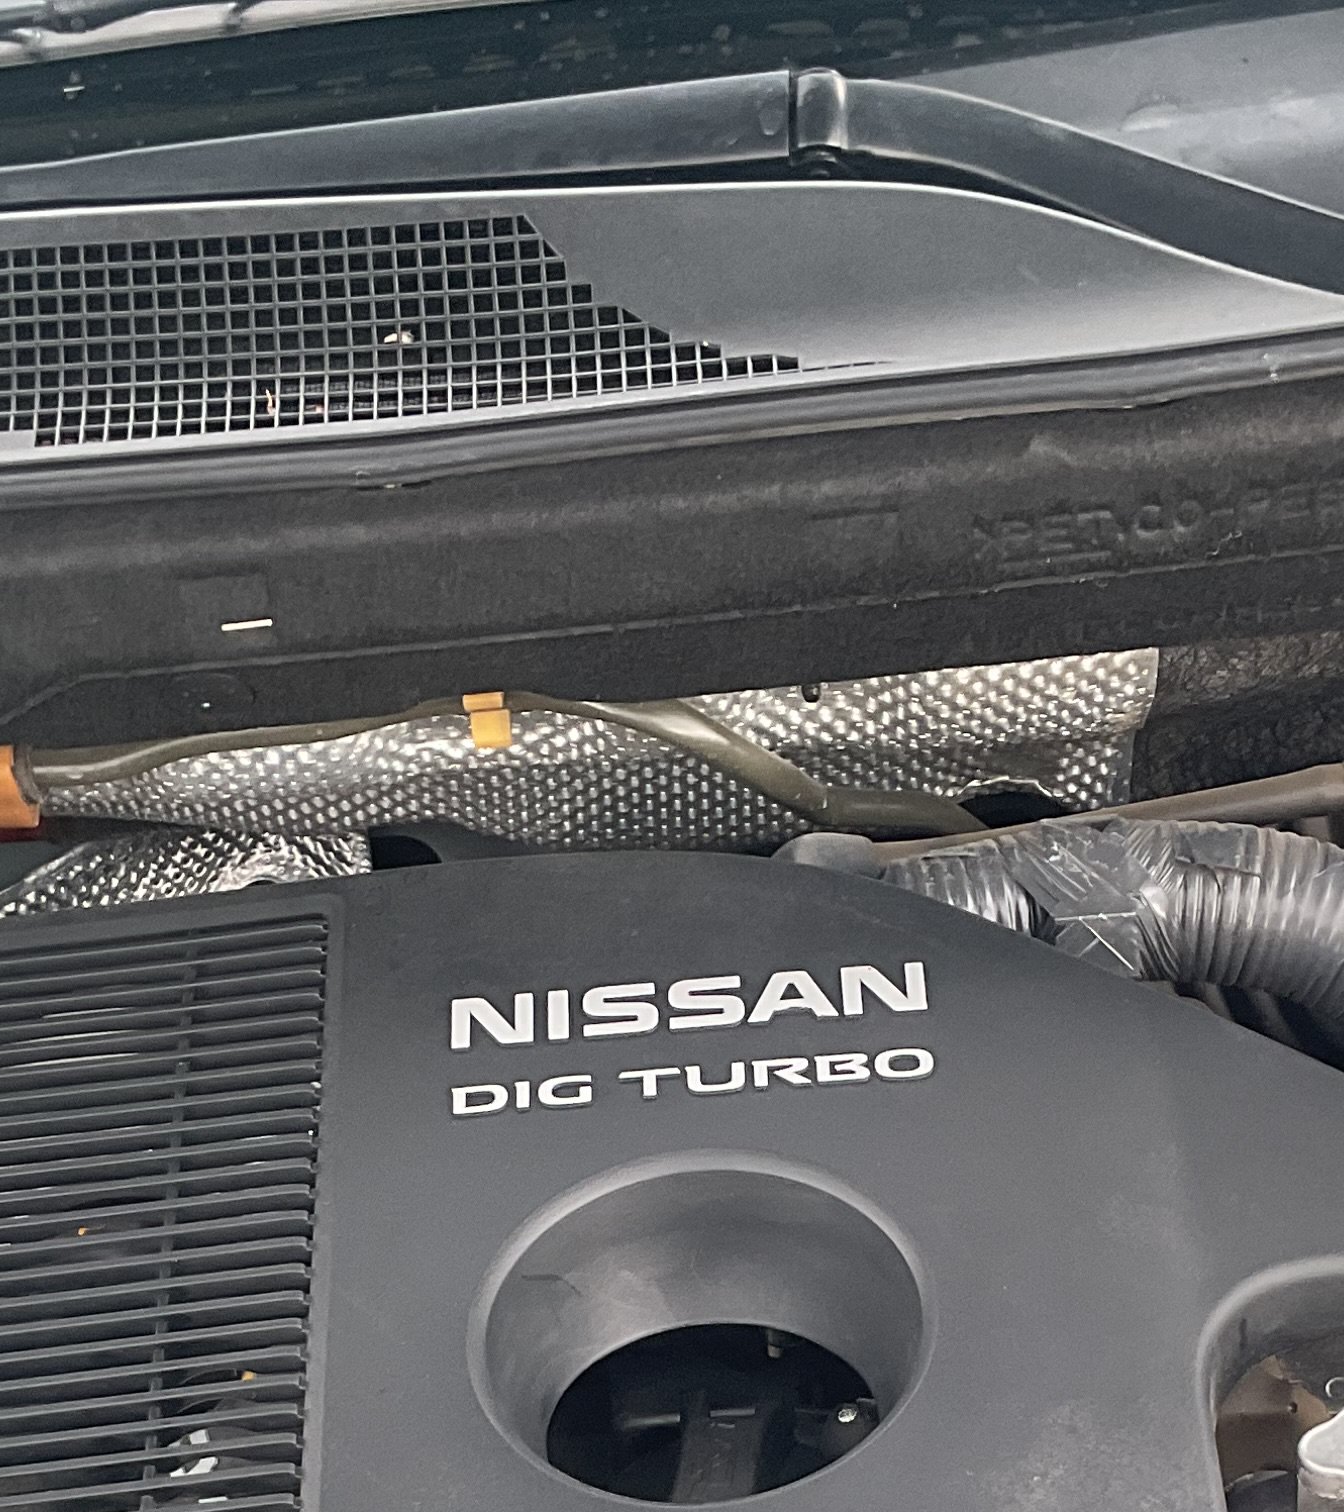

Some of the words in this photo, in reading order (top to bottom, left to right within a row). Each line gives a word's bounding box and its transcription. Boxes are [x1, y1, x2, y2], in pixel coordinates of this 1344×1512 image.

[450, 961, 929, 1050] NISSAN
[451, 1075, 593, 1116] DIG
[618, 1047, 935, 1099] TURBO
